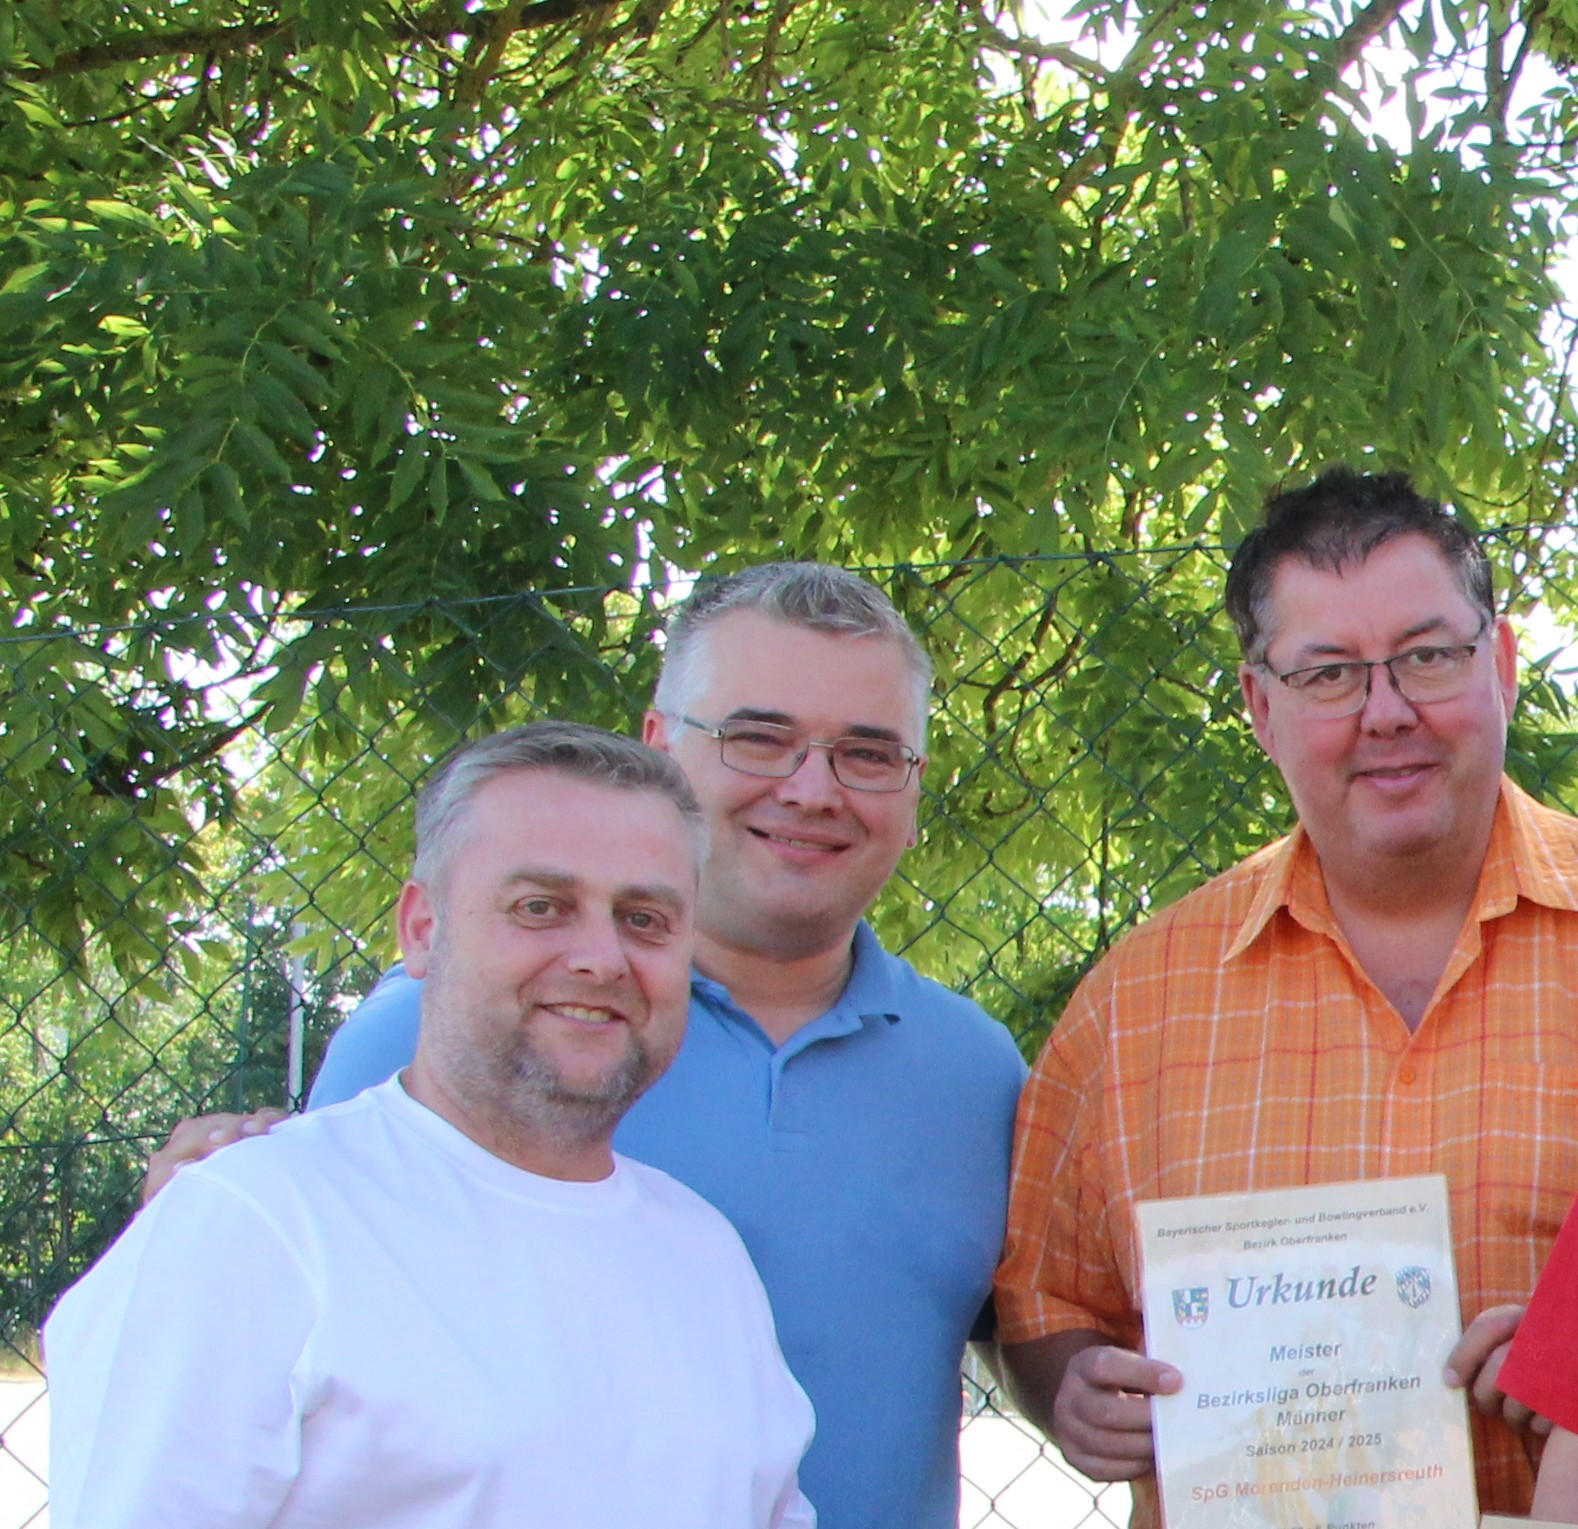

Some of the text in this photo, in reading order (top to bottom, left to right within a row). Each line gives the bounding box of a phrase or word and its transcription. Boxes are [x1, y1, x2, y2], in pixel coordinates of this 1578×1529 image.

[1157, 1222, 1222, 1237] Bayerischer
[1295, 1215, 1315, 1225] und
[1319, 1205, 1406, 1222] Bowlingverband
[1409, 1204, 1429, 1214] e.V.
[1243, 1232, 1347, 1250] Bezirk Oberfranken
[1226, 1265, 1378, 1308] Urkunde
[1270, 1341, 1341, 1362] Meister
[1197, 1374, 1421, 1409] Bezirksliga Oberfranken
[1246, 1442, 1296, 1457] Saison
[1301, 1437, 1335, 1452] 2024
[1349, 1433, 1382, 1448] 2025
[1192, 1484, 1229, 1501] SpG
